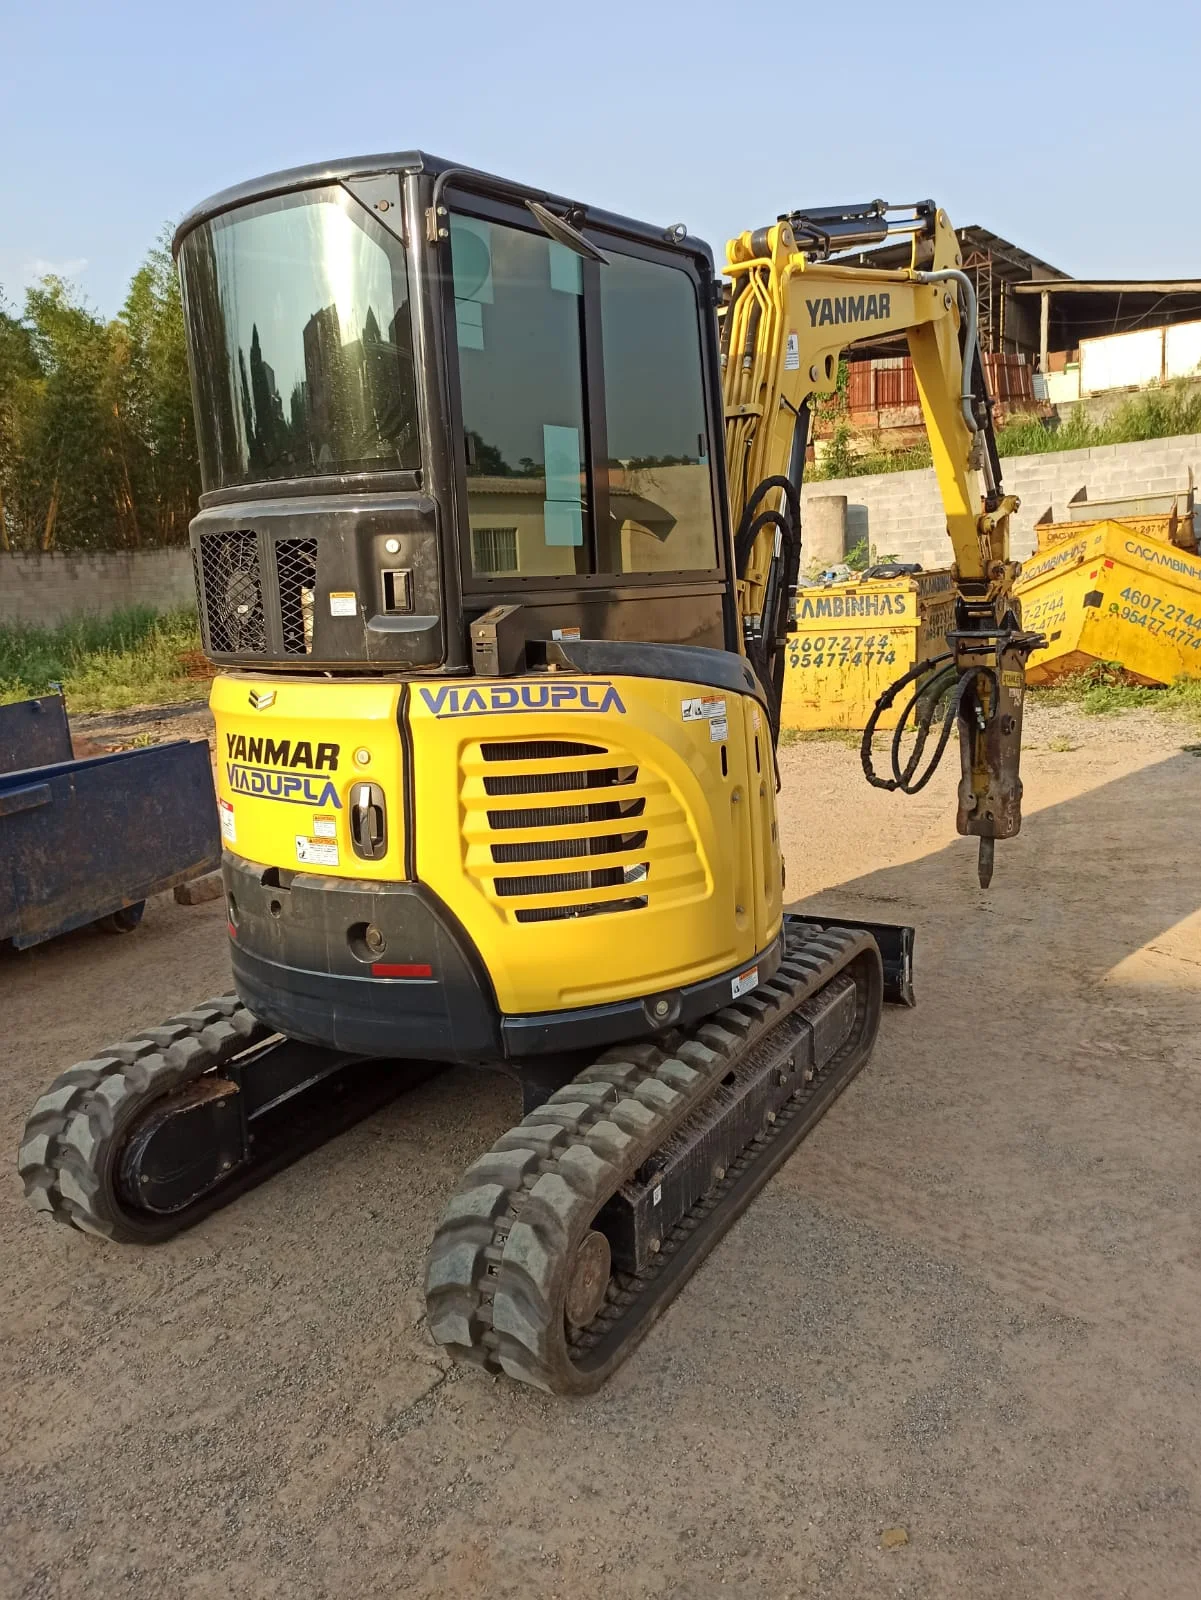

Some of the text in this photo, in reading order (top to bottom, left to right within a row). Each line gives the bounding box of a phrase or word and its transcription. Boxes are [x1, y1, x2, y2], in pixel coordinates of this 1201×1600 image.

[806, 293, 890, 328] YANMAR
[1120, 587, 1201, 631] 4607-2744
[419, 684, 627, 715] VIADUPLA
[226, 733, 341, 771] YANMAR
[226, 762, 343, 809] VIADUPLA
